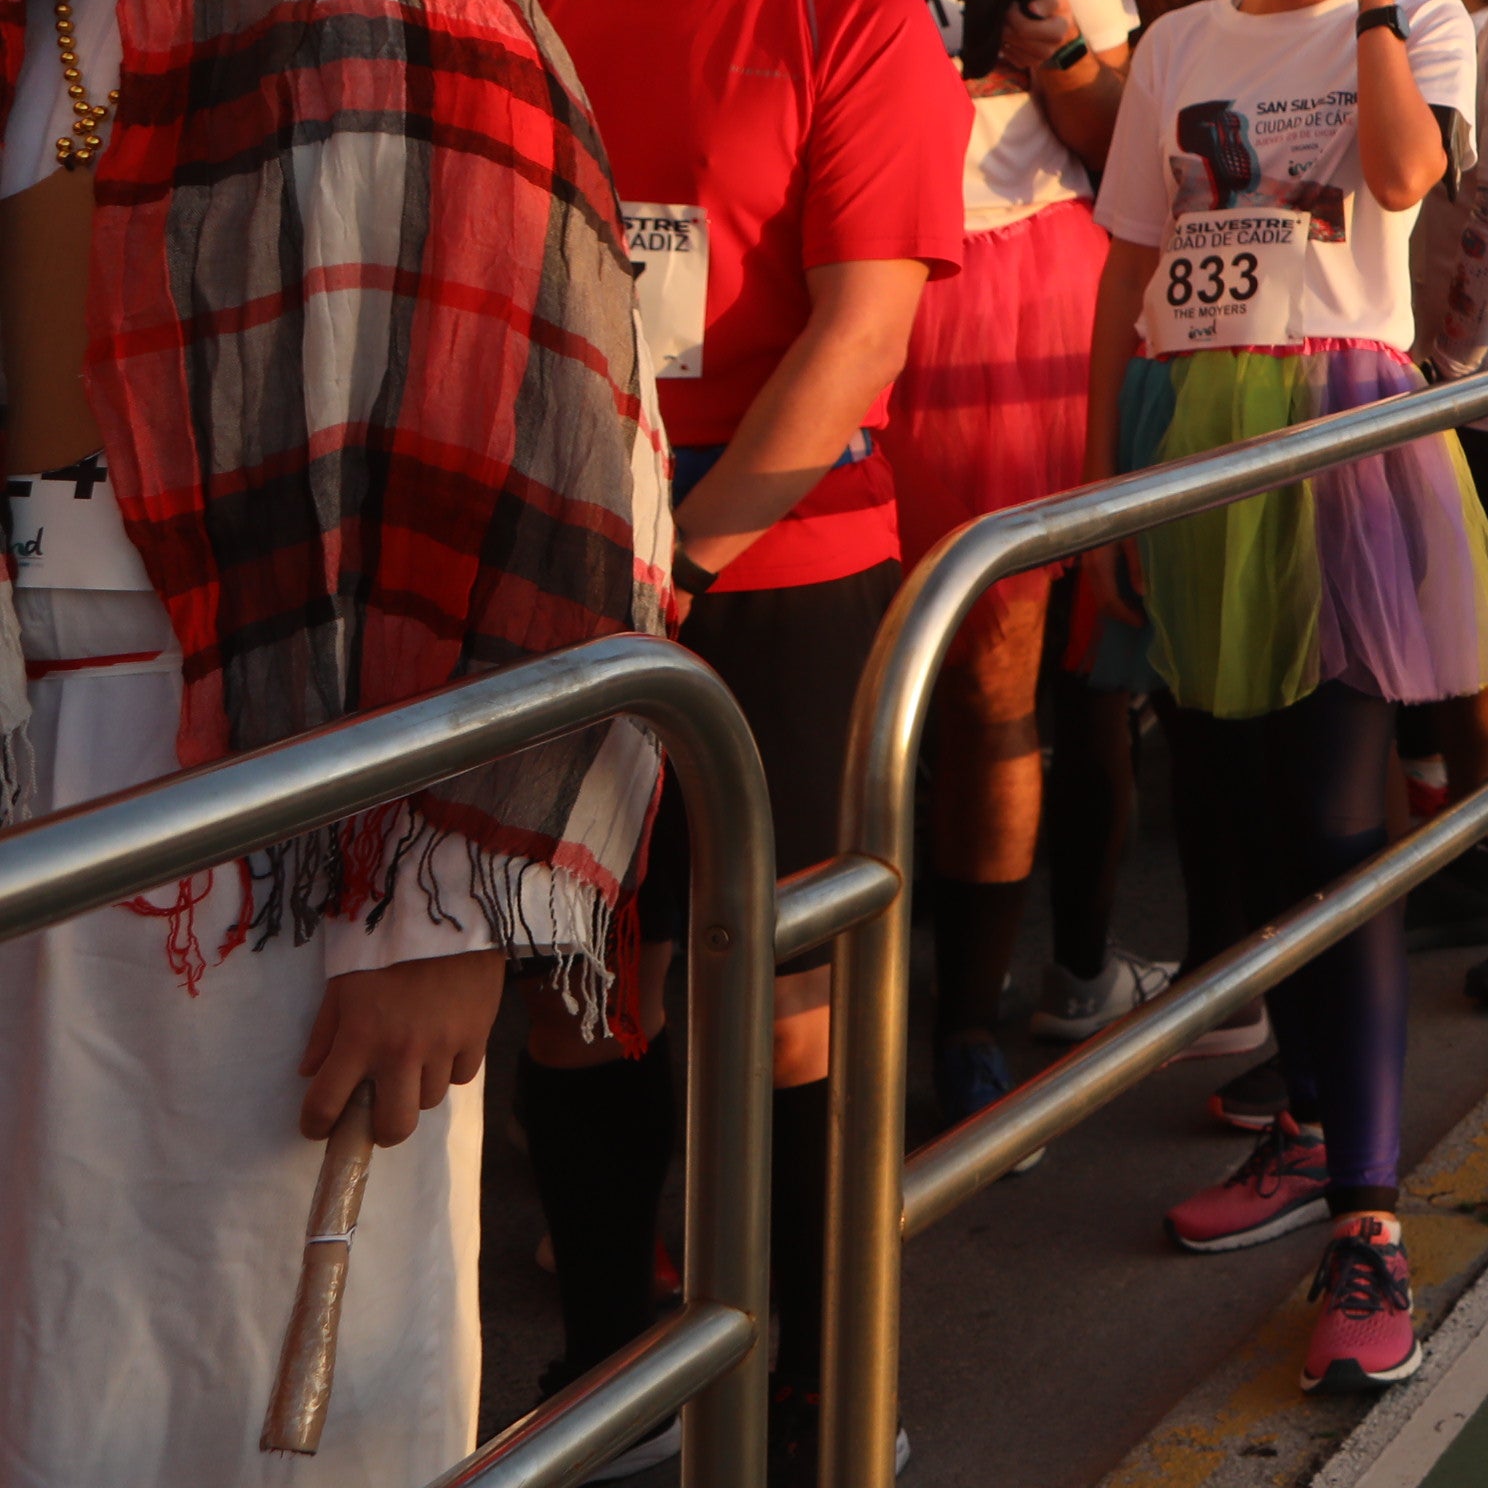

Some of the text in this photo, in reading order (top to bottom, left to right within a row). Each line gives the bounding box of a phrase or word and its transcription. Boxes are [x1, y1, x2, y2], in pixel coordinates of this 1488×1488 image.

[1256, 100, 1288, 115] SAN
[1255, 116, 1302, 135] CIUDAD
[1304, 112, 1322, 127] DE
[1187, 218, 1295, 234] SILVESTRE
[1211, 232, 1232, 248] DE
[1166, 252, 1259, 306] 833
[1173, 303, 1247, 319] THE MOYERS
